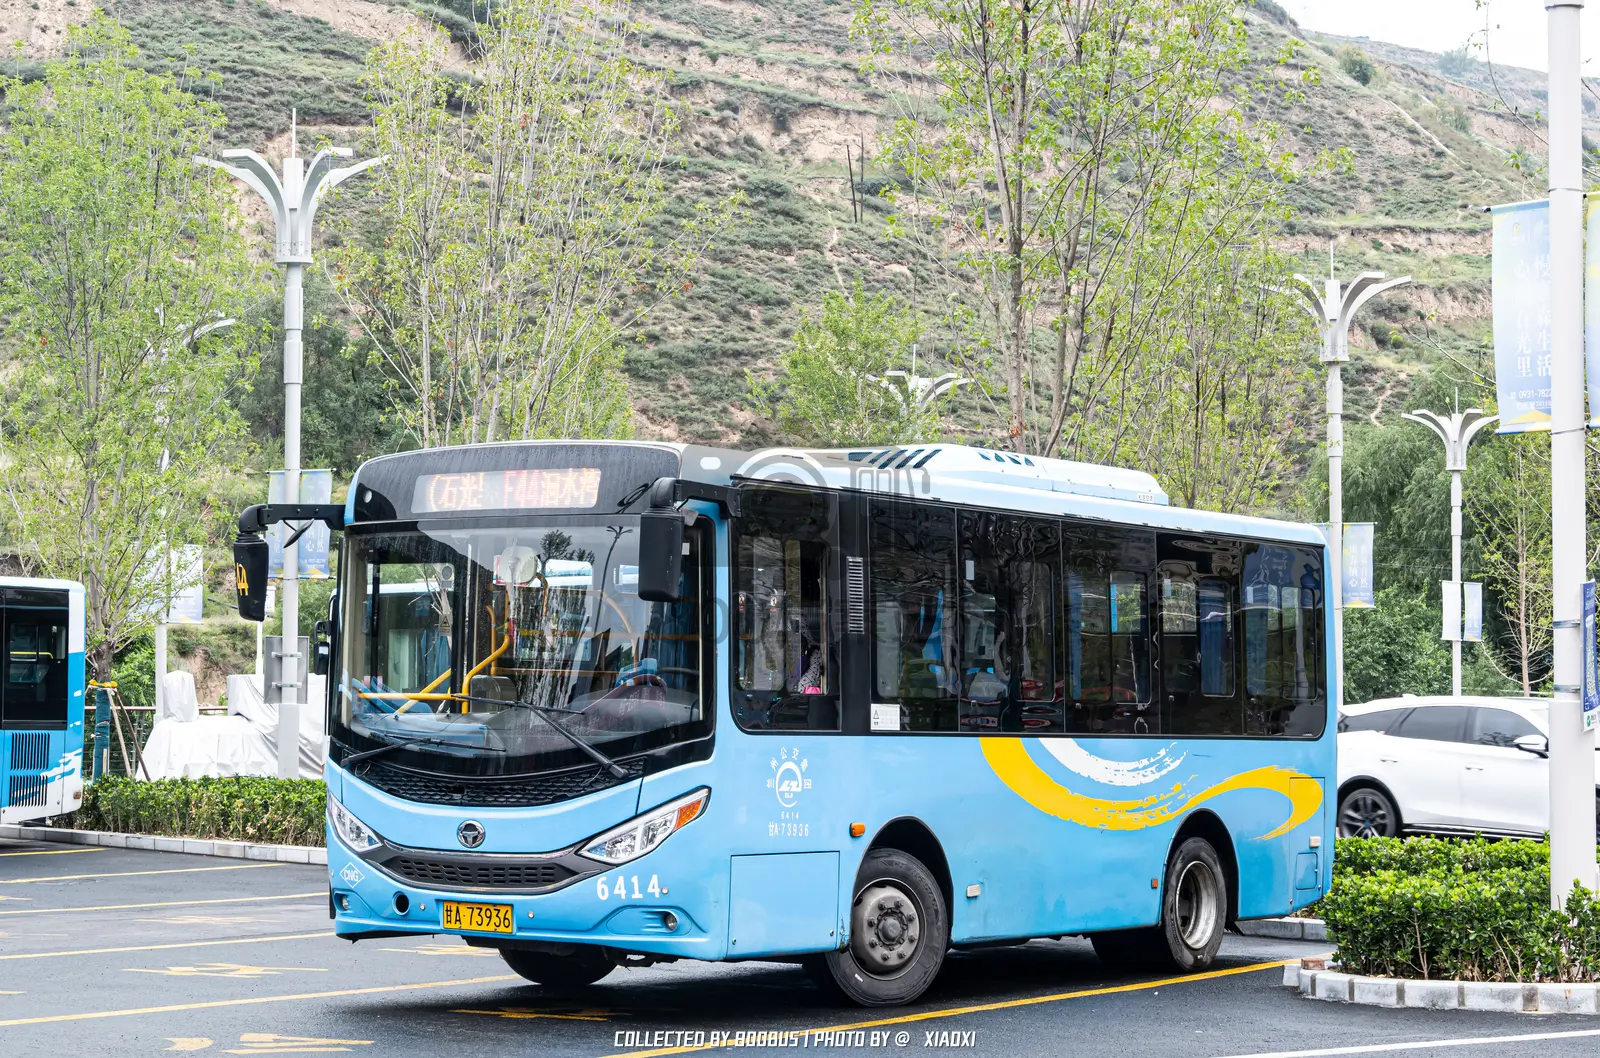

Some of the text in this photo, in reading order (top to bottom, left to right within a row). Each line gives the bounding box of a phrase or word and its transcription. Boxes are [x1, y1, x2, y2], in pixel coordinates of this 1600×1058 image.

[781, 811, 800, 820] 6414
[343, 870, 359, 881] CNG
[596, 874, 661, 900] 6414
